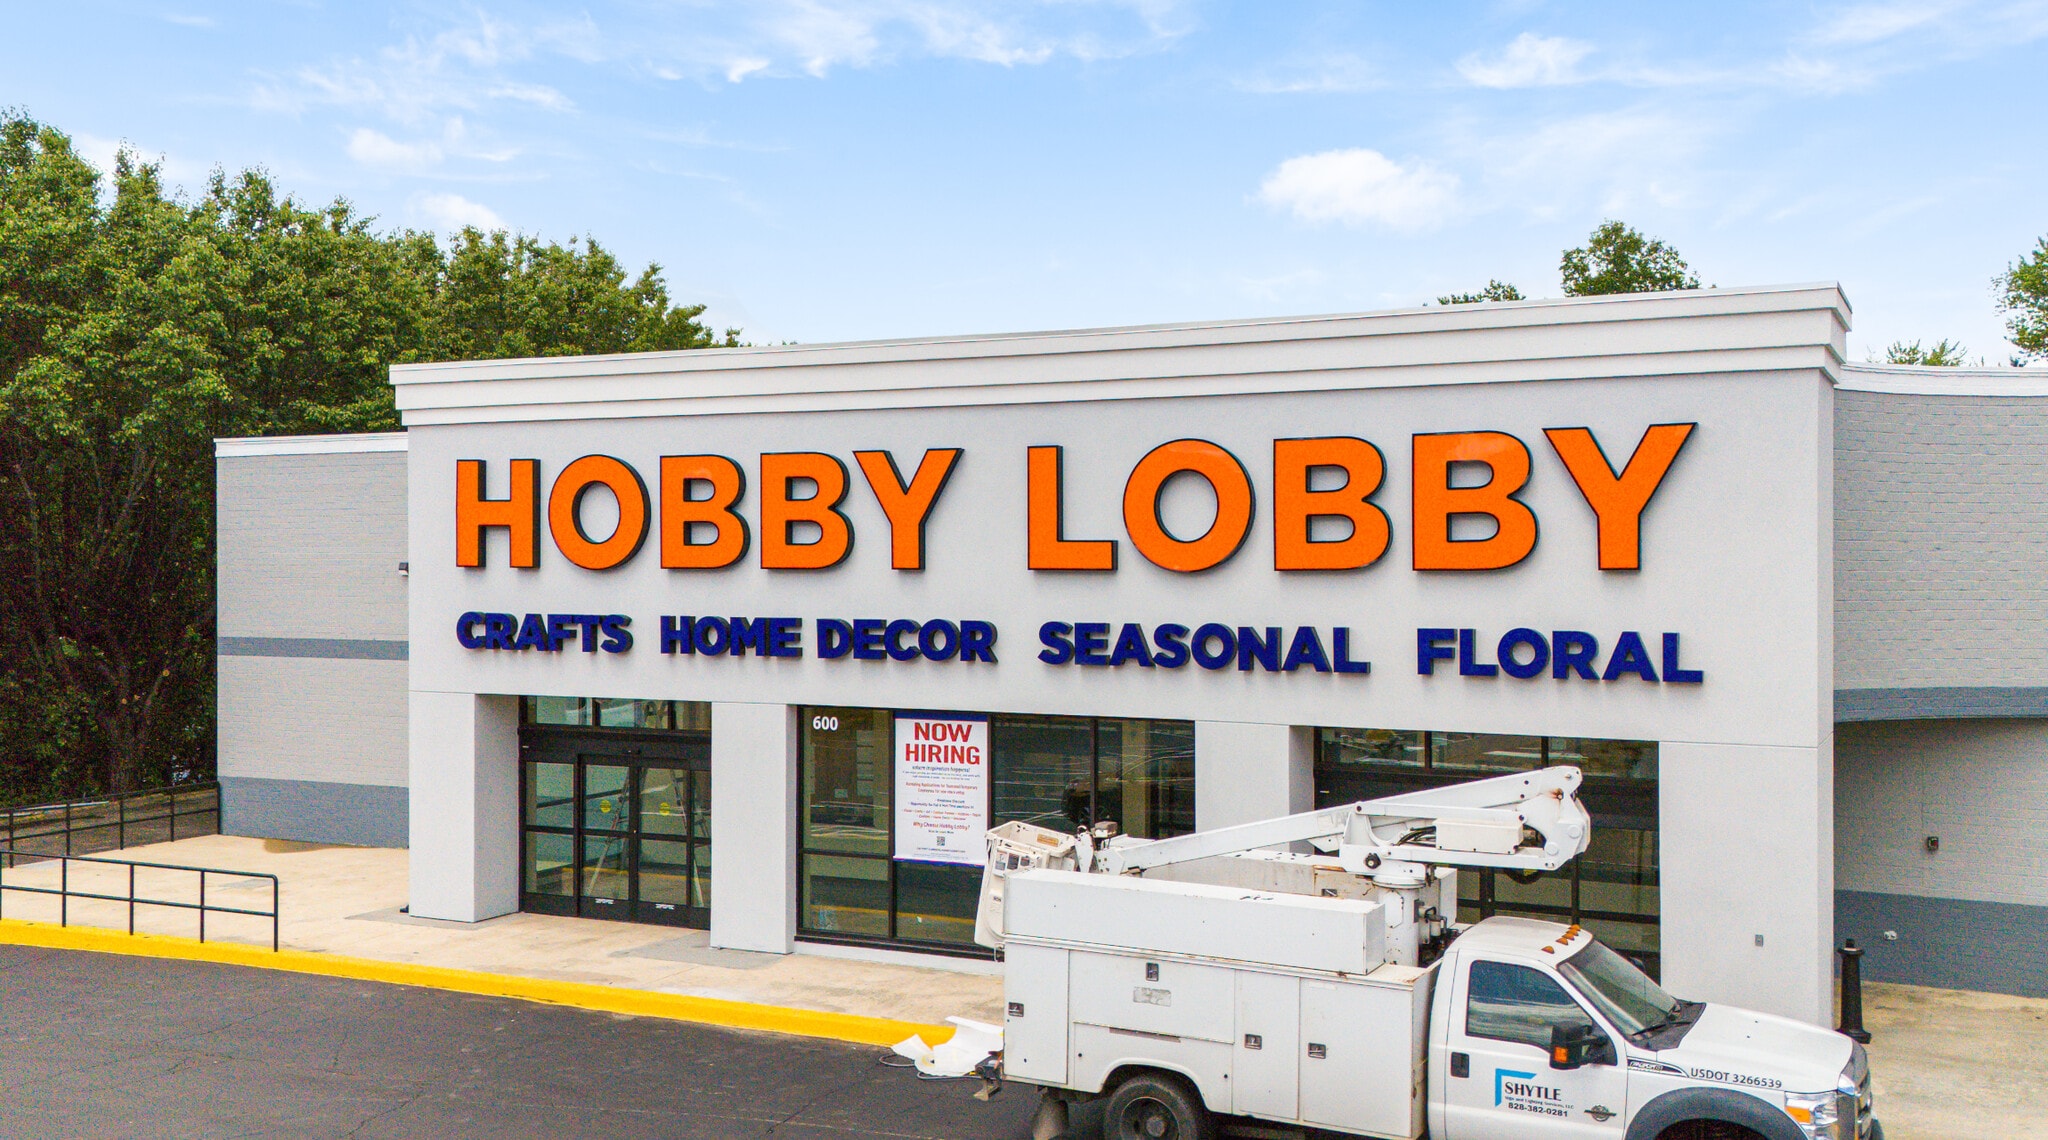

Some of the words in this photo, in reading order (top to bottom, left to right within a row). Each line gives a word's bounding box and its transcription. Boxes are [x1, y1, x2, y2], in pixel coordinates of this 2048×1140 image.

[456, 447, 963, 572] HOBBY
[1028, 423, 1693, 573] LOBBY
[456, 611, 632, 654] CRAFTS
[660, 615, 802, 658] HOME
[818, 617, 996, 663] DECOR
[1039, 620, 1369, 675] SEASONAL
[1417, 627, 1705, 684] FLORAL
[813, 715, 838, 731] 600
[914, 722, 973, 742] NOW
[905, 743, 980, 765] HIRING
[1690, 1068, 1729, 1082] USDOT
[1733, 1073, 1782, 1089] 3266539
[1504, 1081, 1562, 1102] SHYTLE
[1508, 1102, 1568, 1118] 828-382-0281
